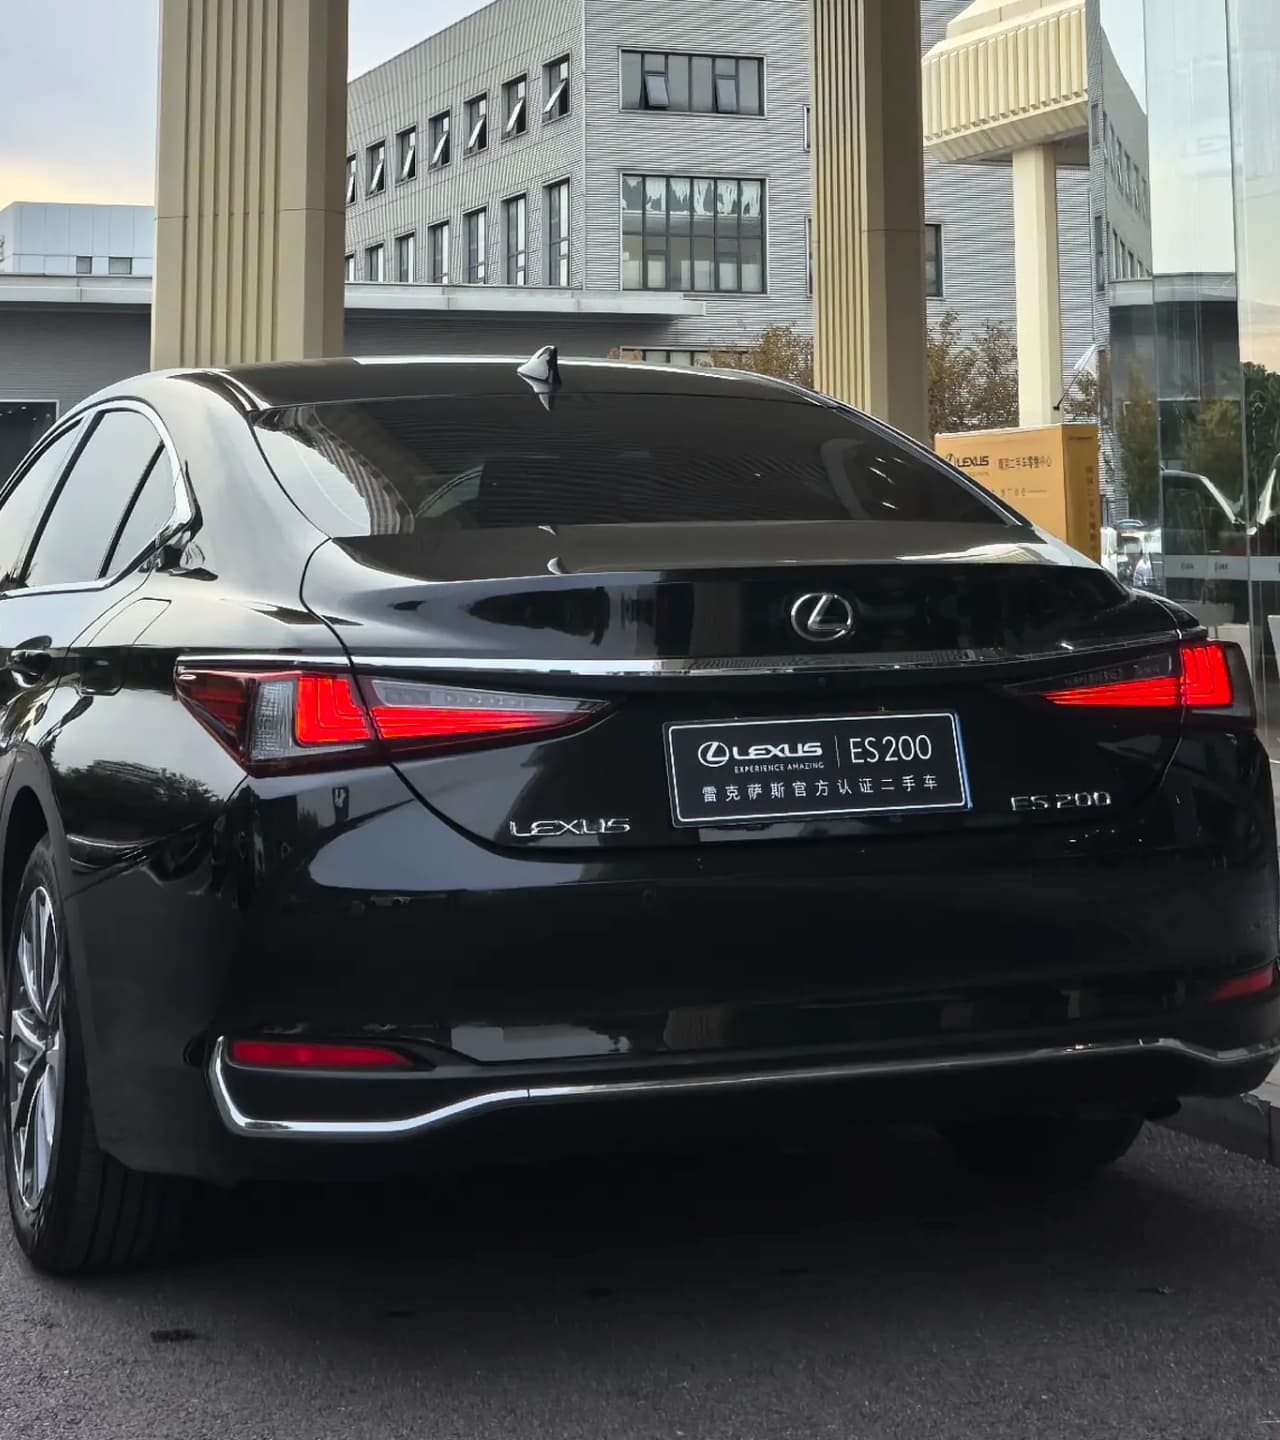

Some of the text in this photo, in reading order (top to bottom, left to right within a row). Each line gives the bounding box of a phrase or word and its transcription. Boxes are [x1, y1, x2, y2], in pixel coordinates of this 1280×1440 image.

[957, 456, 989, 467] LEXUS
[733, 742, 823, 760] LEXUS
[735, 762, 824, 774] EXPERIENCE AMAZING
[702, 774, 938, 803] 雷克萨斯官方认证二手车
[509, 818, 631, 837] LEXUS
